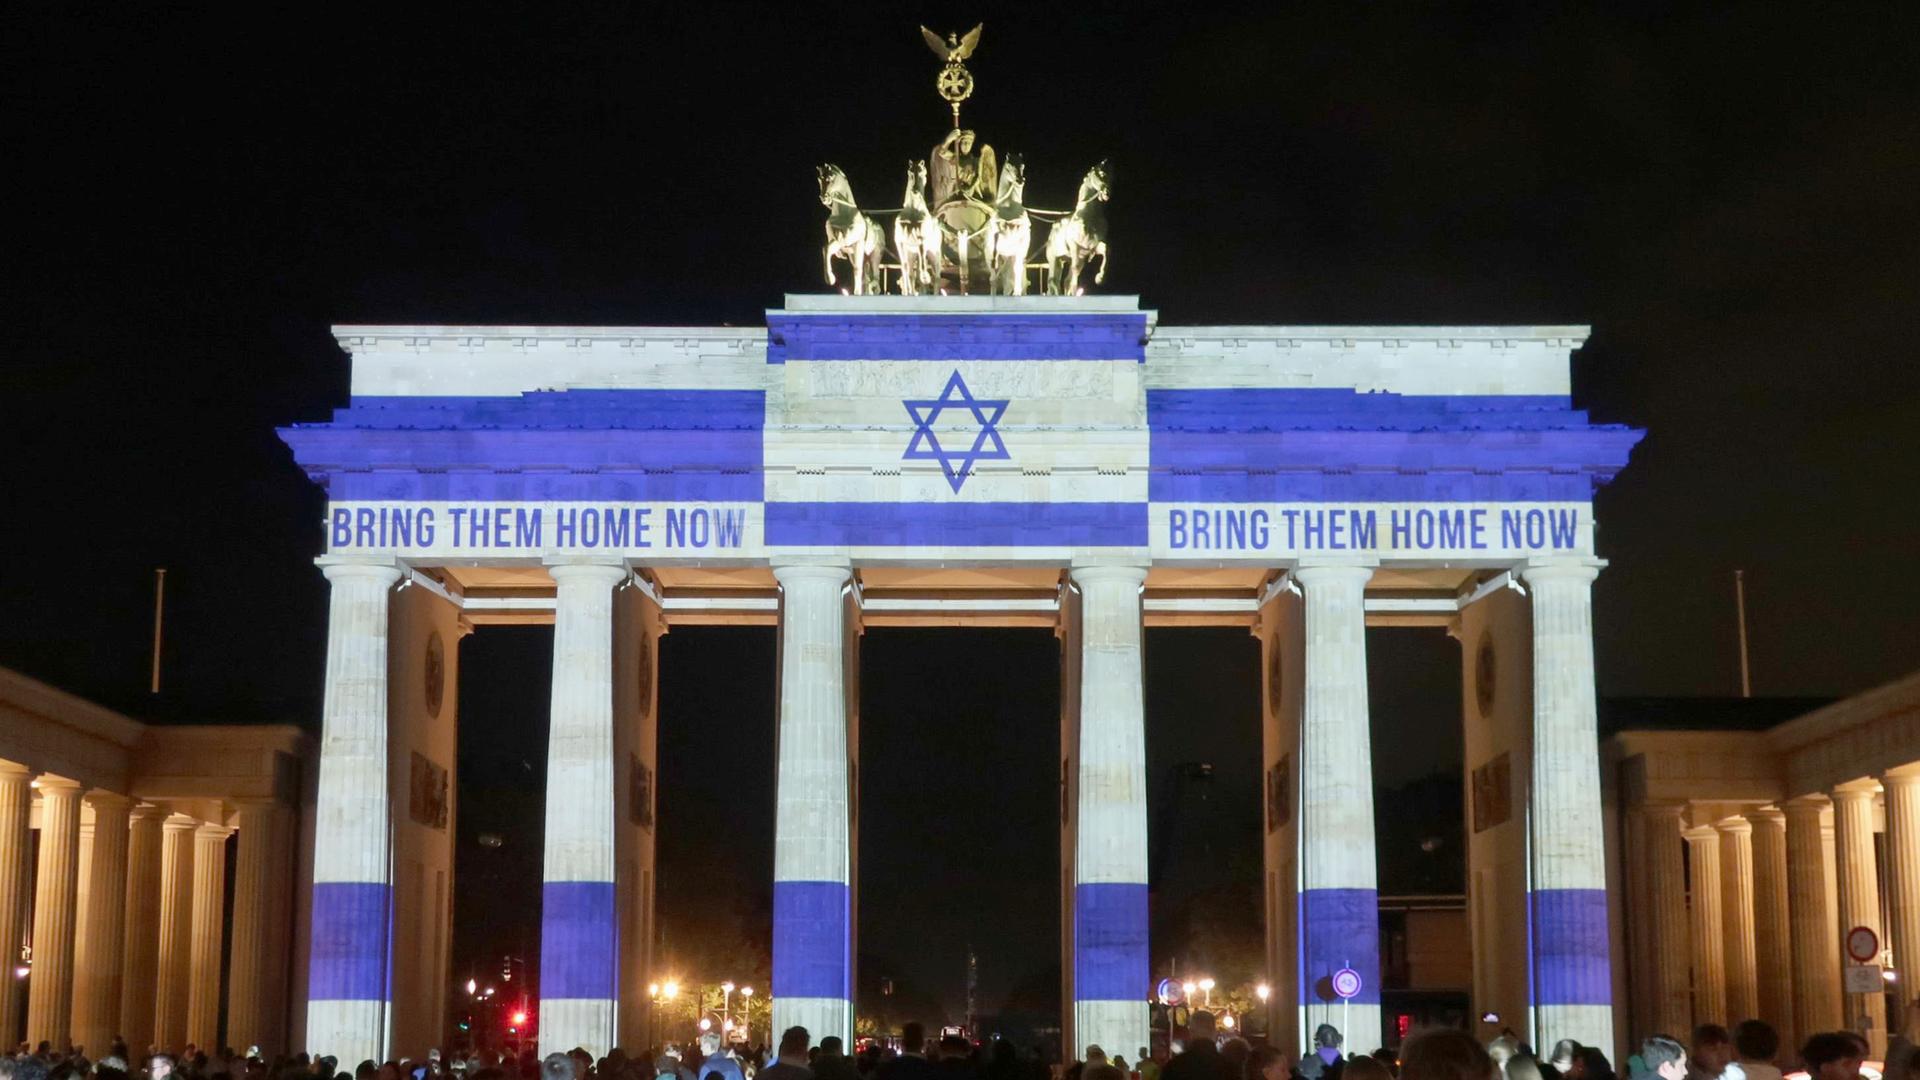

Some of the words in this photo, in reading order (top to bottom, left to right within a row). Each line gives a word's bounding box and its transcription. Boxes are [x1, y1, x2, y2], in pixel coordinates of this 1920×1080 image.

[332, 508, 435, 548] BRING
[448, 508, 542, 548] THEM
[556, 508, 652, 548] HOME
[666, 508, 746, 548] NOW
[1169, 509, 1269, 550] BRING
[1281, 509, 1377, 550] THEM
[1391, 508, 1488, 549] HOME
[1501, 508, 1577, 549] NOW
